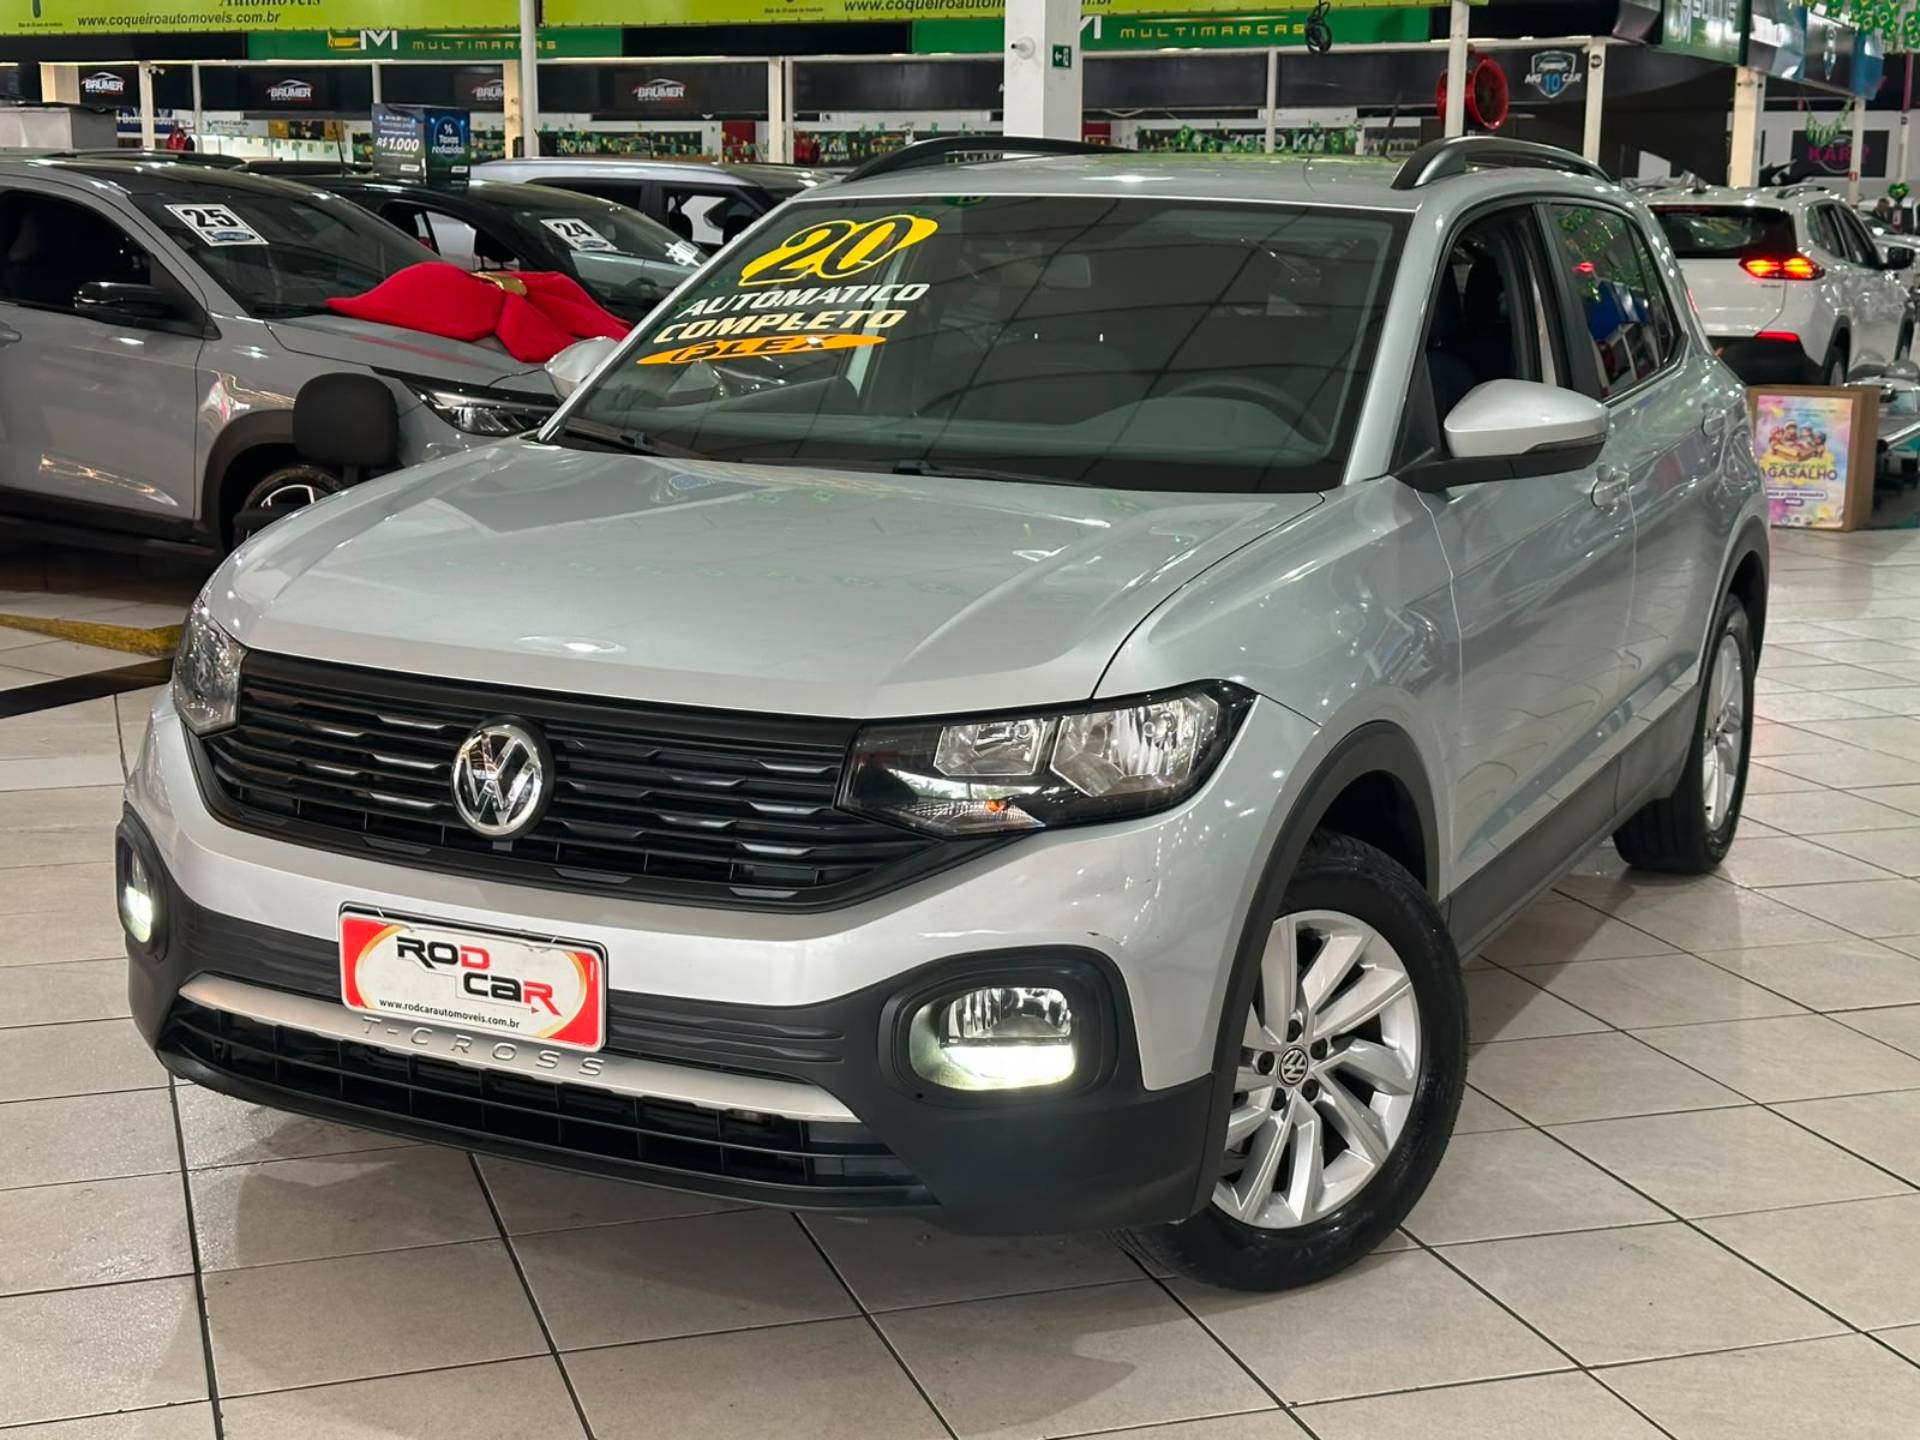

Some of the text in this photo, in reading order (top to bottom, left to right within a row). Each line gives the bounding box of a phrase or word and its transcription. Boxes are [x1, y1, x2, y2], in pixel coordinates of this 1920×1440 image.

[77, 12, 281, 27] www.coqueiroautomoveis.com.br
[1120, 23, 1305, 39] MULTIMARCAS
[412, 40, 557, 50] MULTIMARAS
[181, 209, 239, 228] 25
[553, 222, 593, 237] 24
[738, 214, 938, 286] 20
[653, 309, 908, 344] COMPLETO
[669, 336, 828, 363] FLEX
[379, 998, 520, 1029] www.rodcarautomoveis.com.br
[362, 1015, 604, 1077] T-CROSS
